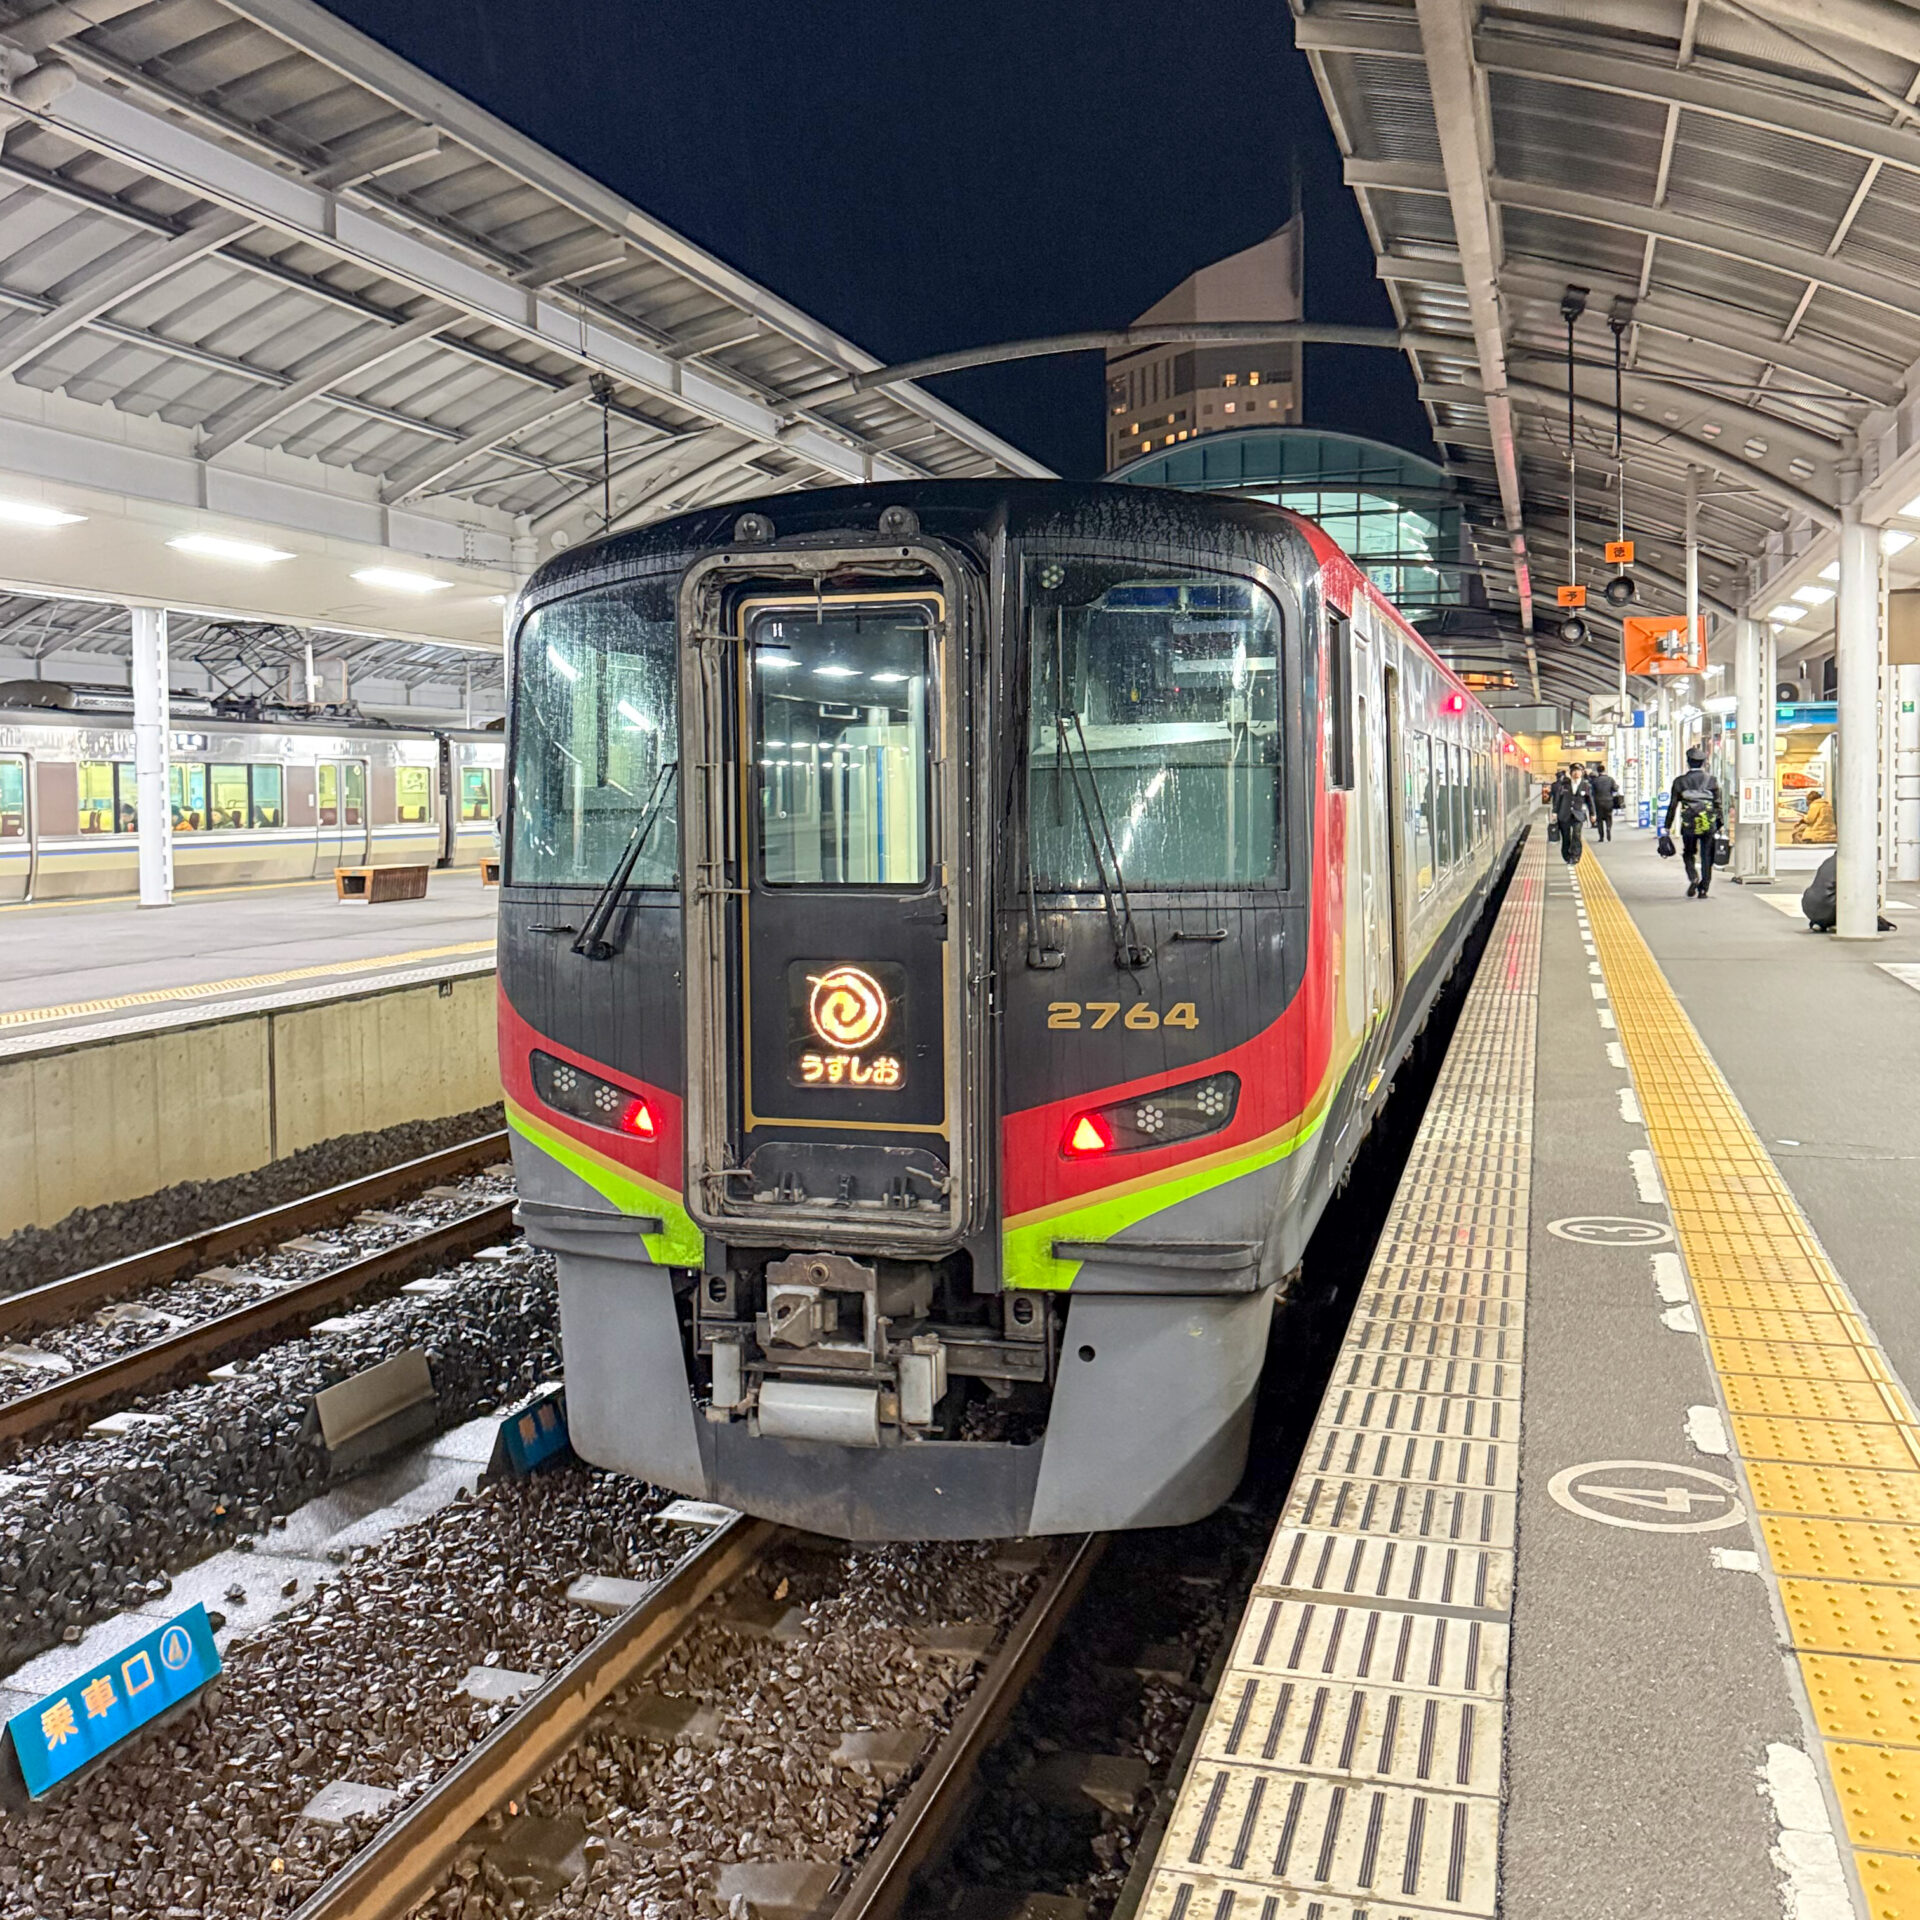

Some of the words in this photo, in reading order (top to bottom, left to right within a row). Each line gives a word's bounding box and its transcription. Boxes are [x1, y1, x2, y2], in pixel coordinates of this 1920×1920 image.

[1048, 1002, 1199, 1030] 2764
[801, 1054, 900, 1084] うずしお
[40, 1650, 155, 1751] 乗車口
